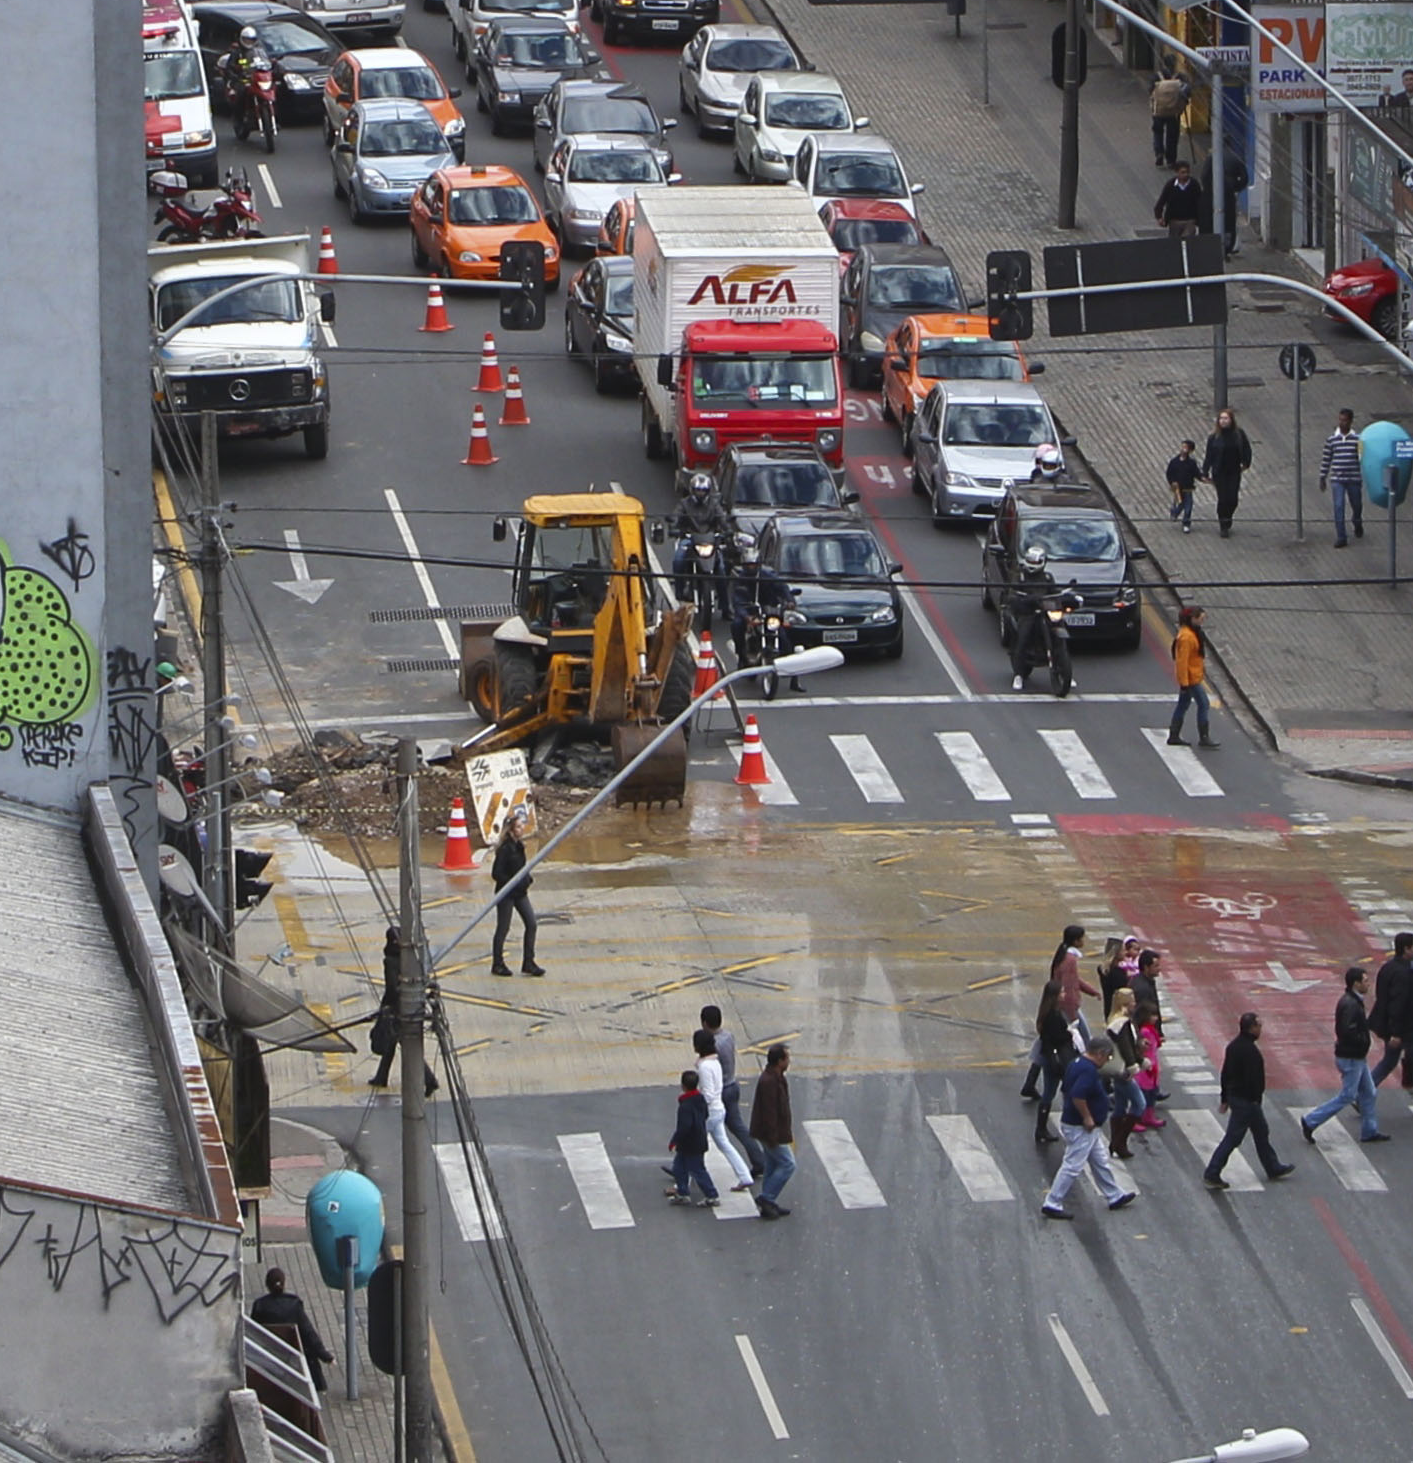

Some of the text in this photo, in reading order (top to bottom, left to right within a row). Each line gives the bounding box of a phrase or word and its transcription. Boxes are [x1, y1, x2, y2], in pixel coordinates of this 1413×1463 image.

[1259, 69, 1306, 84] PARK
[687, 275, 798, 305] ALFA
[728, 305, 821, 316] TRANSPORTES
